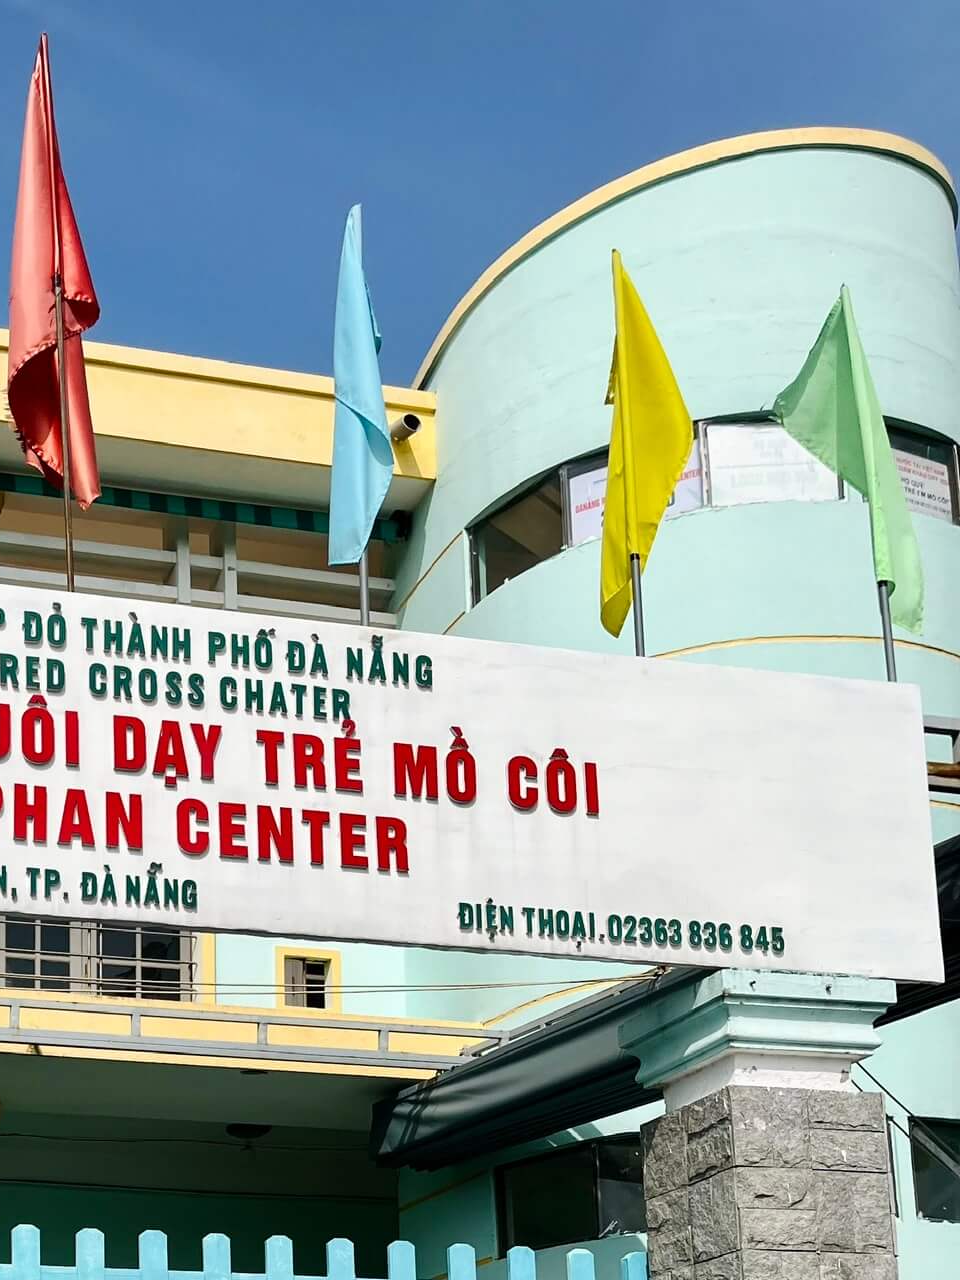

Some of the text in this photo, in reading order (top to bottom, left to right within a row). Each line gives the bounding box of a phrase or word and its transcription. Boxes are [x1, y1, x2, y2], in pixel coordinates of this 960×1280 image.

[82, 612, 190, 660] THÀNH
[209, 629, 275, 670] PHỐ
[287, 634, 328, 677] ĐÀ
[0, 654, 65, 693] RED
[90, 663, 204, 707] CROSS
[220, 677, 350, 720] CHATER
[113, 715, 221, 788] DẠY
[256, 720, 364, 793] TRẺ
[394, 727, 476, 805] MỒ
[508, 749, 599, 816] CÔI
[177, 799, 409, 873] CENTER
[27, 868, 68, 899] TP.
[81, 865, 116, 903] ĐÀ
[458, 898, 513, 940] ĐIỆN
[689, 921, 732, 950] 836
[741, 925, 784, 952] 845
